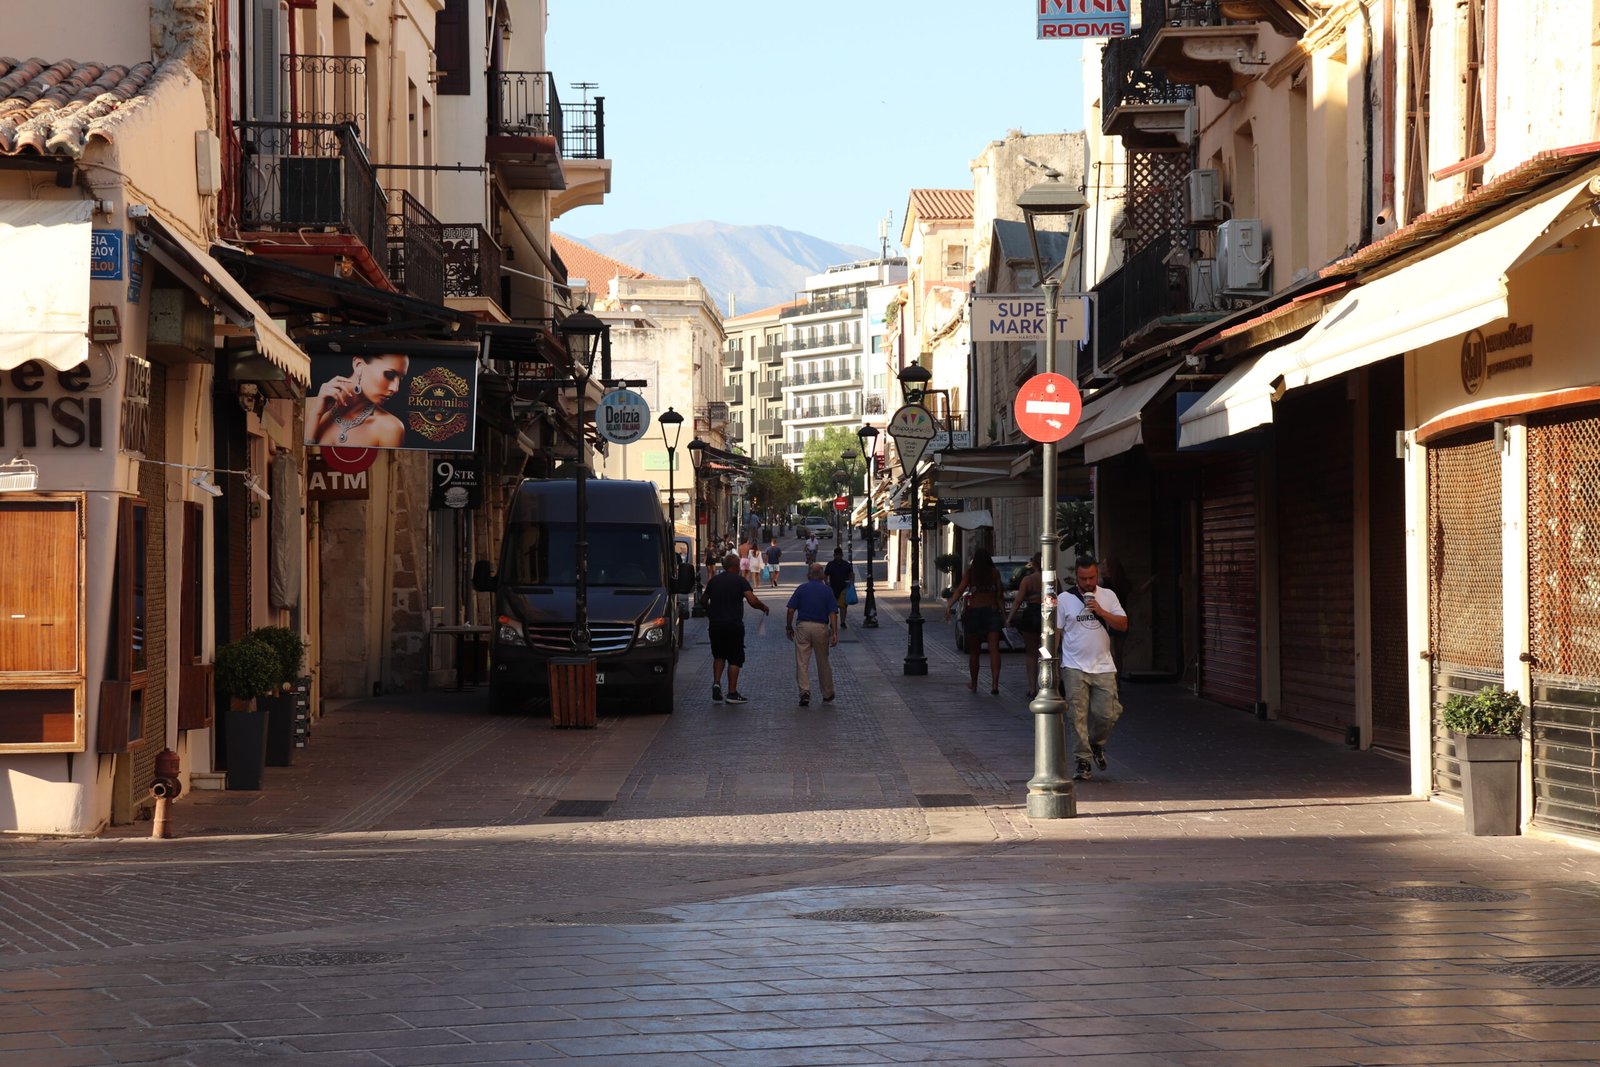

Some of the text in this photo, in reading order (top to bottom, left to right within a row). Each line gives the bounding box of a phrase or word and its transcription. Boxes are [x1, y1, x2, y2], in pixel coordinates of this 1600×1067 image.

[1043, 23, 1125, 37] ROOMS
[998, 303, 1046, 318] SUPE
[989, 318, 1068, 334] MARKT
[0, 358, 92, 392] ee
[605, 406, 640, 423] Delizia
[309, 471, 367, 490] ATM
